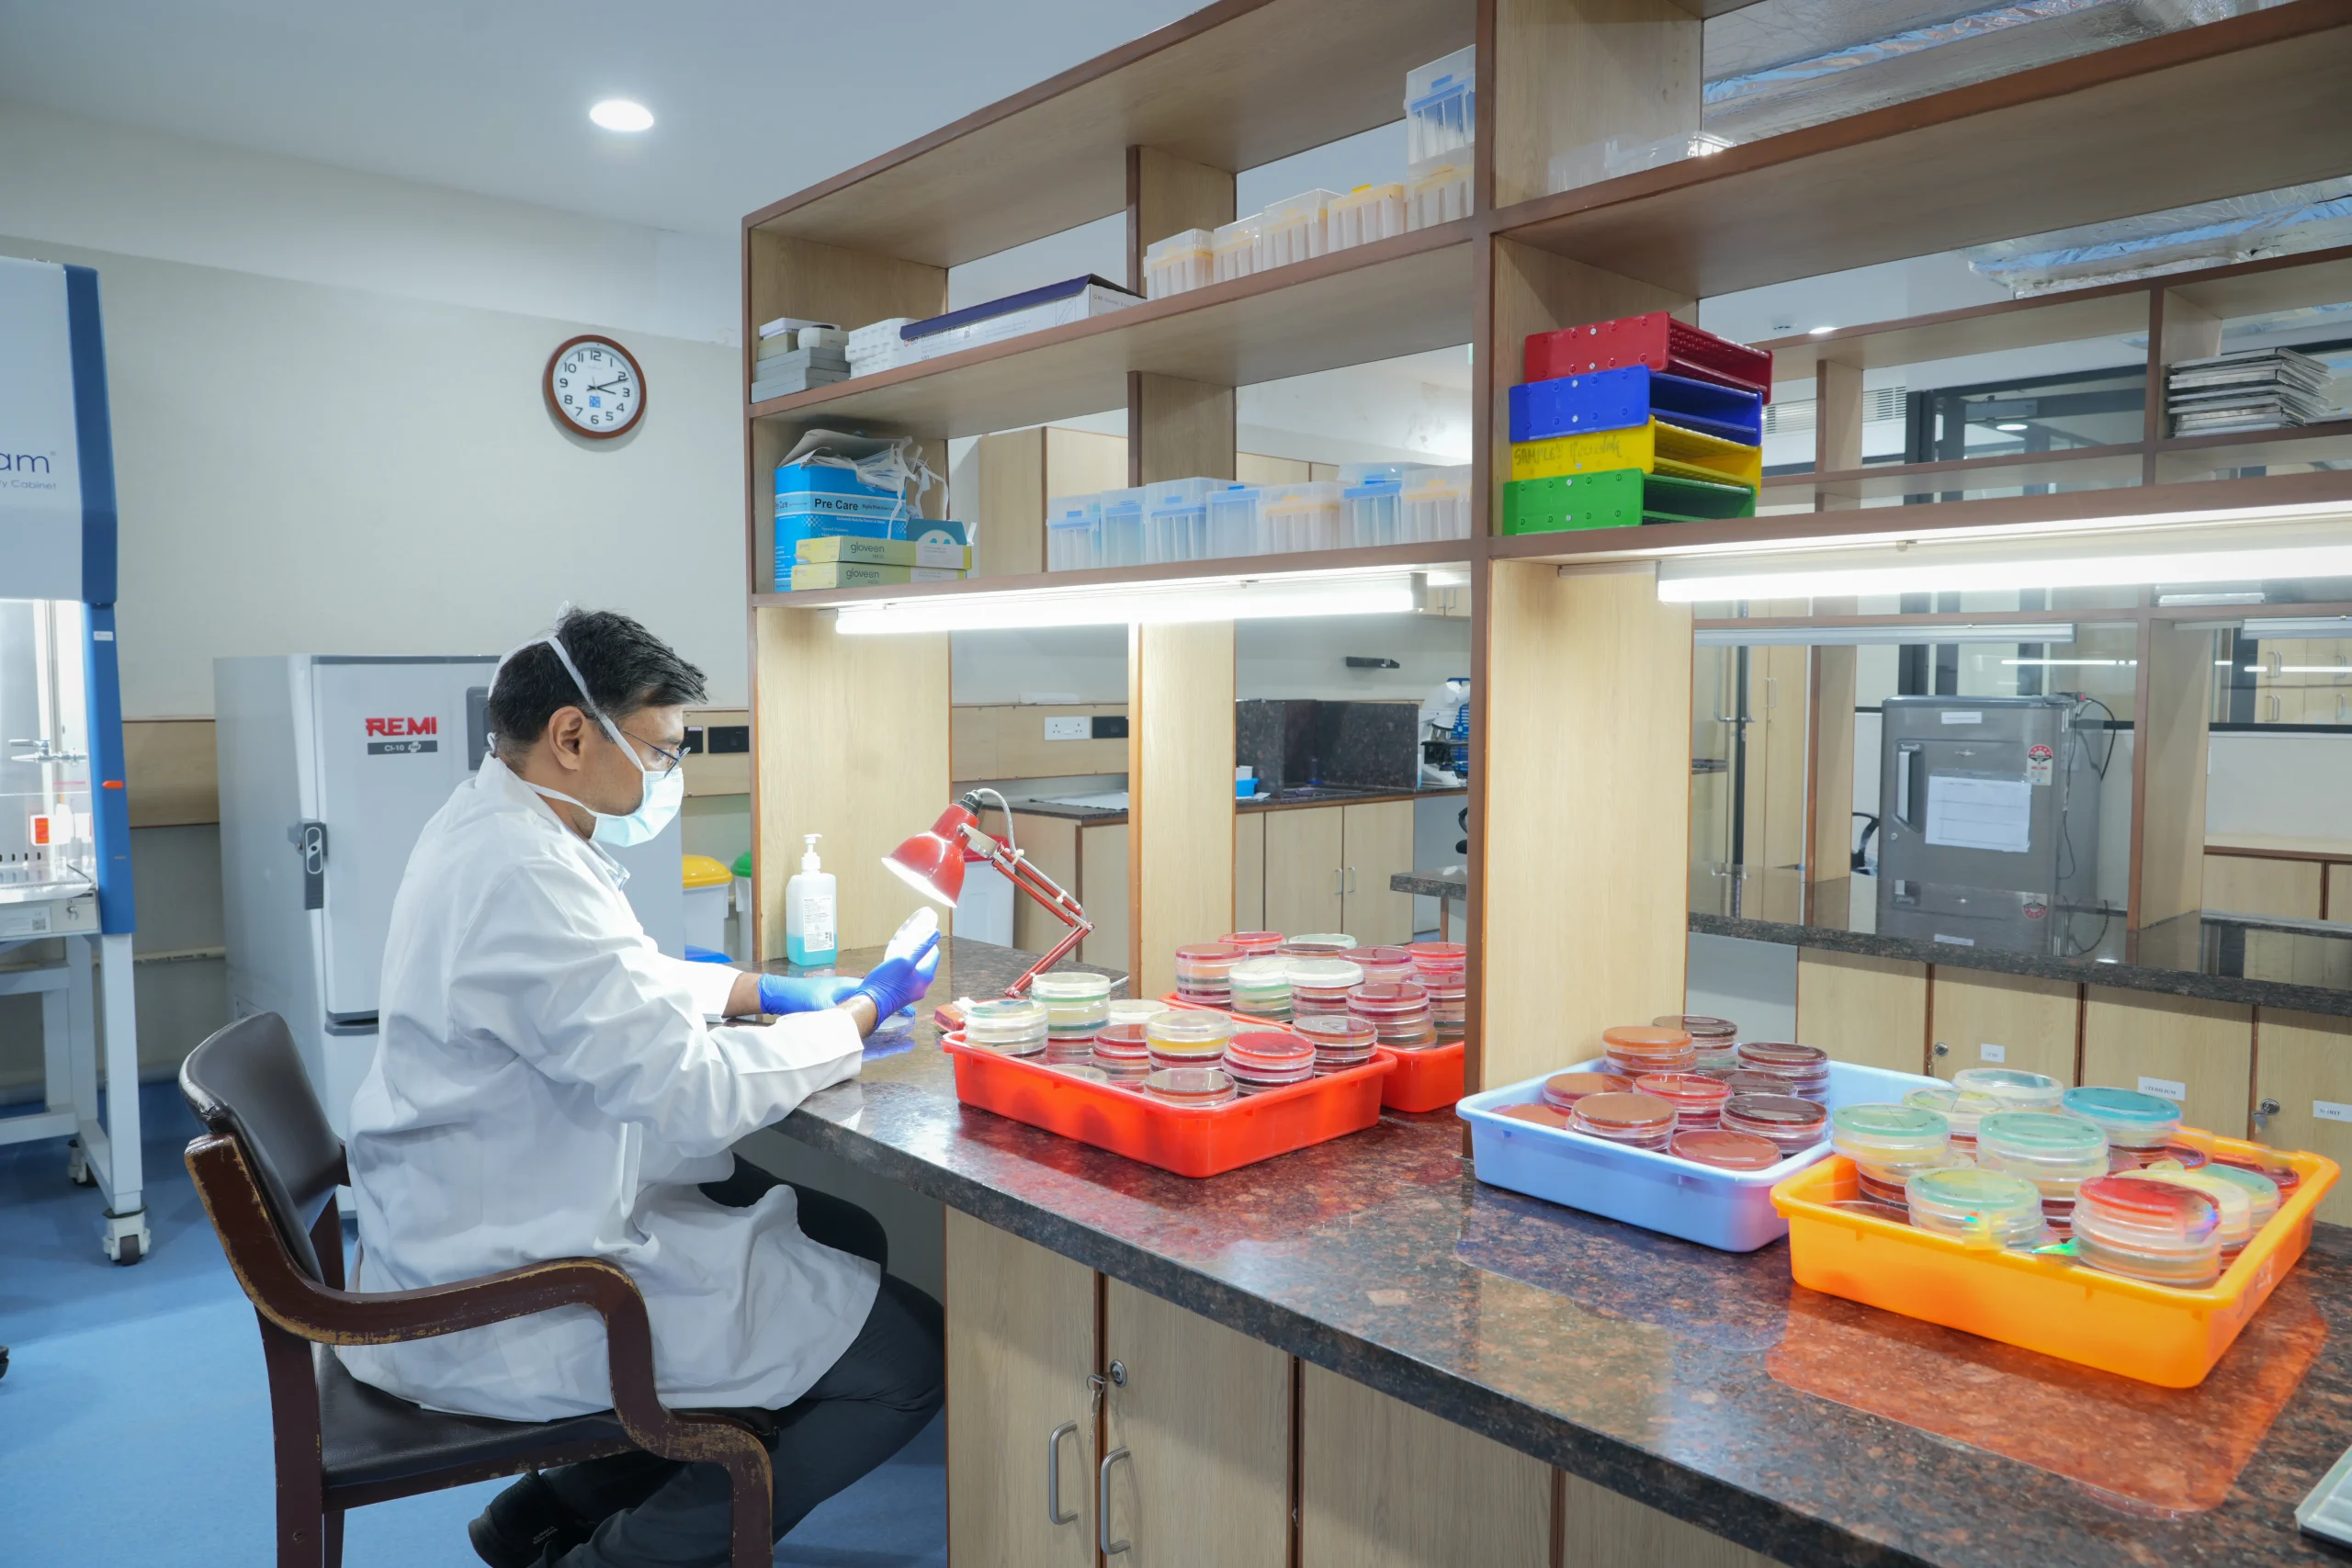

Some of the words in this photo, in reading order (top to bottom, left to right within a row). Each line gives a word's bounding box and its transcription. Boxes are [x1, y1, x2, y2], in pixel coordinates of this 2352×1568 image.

[577, 352, 583, 363] 11
[590, 349, 602, 361] 12
[563, 362, 577, 374] 10
[617, 371, 627, 381] 2
[560, 378, 569, 389] 9
[622, 388, 630, 398] 3
[564, 394, 573, 405] 8
[574, 406, 583, 417] 7
[616, 402, 625, 412] 4
[590, 414, 599, 424] 6
[605, 411, 614, 422] 5
[11, 479, 56, 491] Cabinet
[814, 498, 832, 509] Pre
[835, 500, 858, 511] Care
[365, 716, 437, 737] REMI
